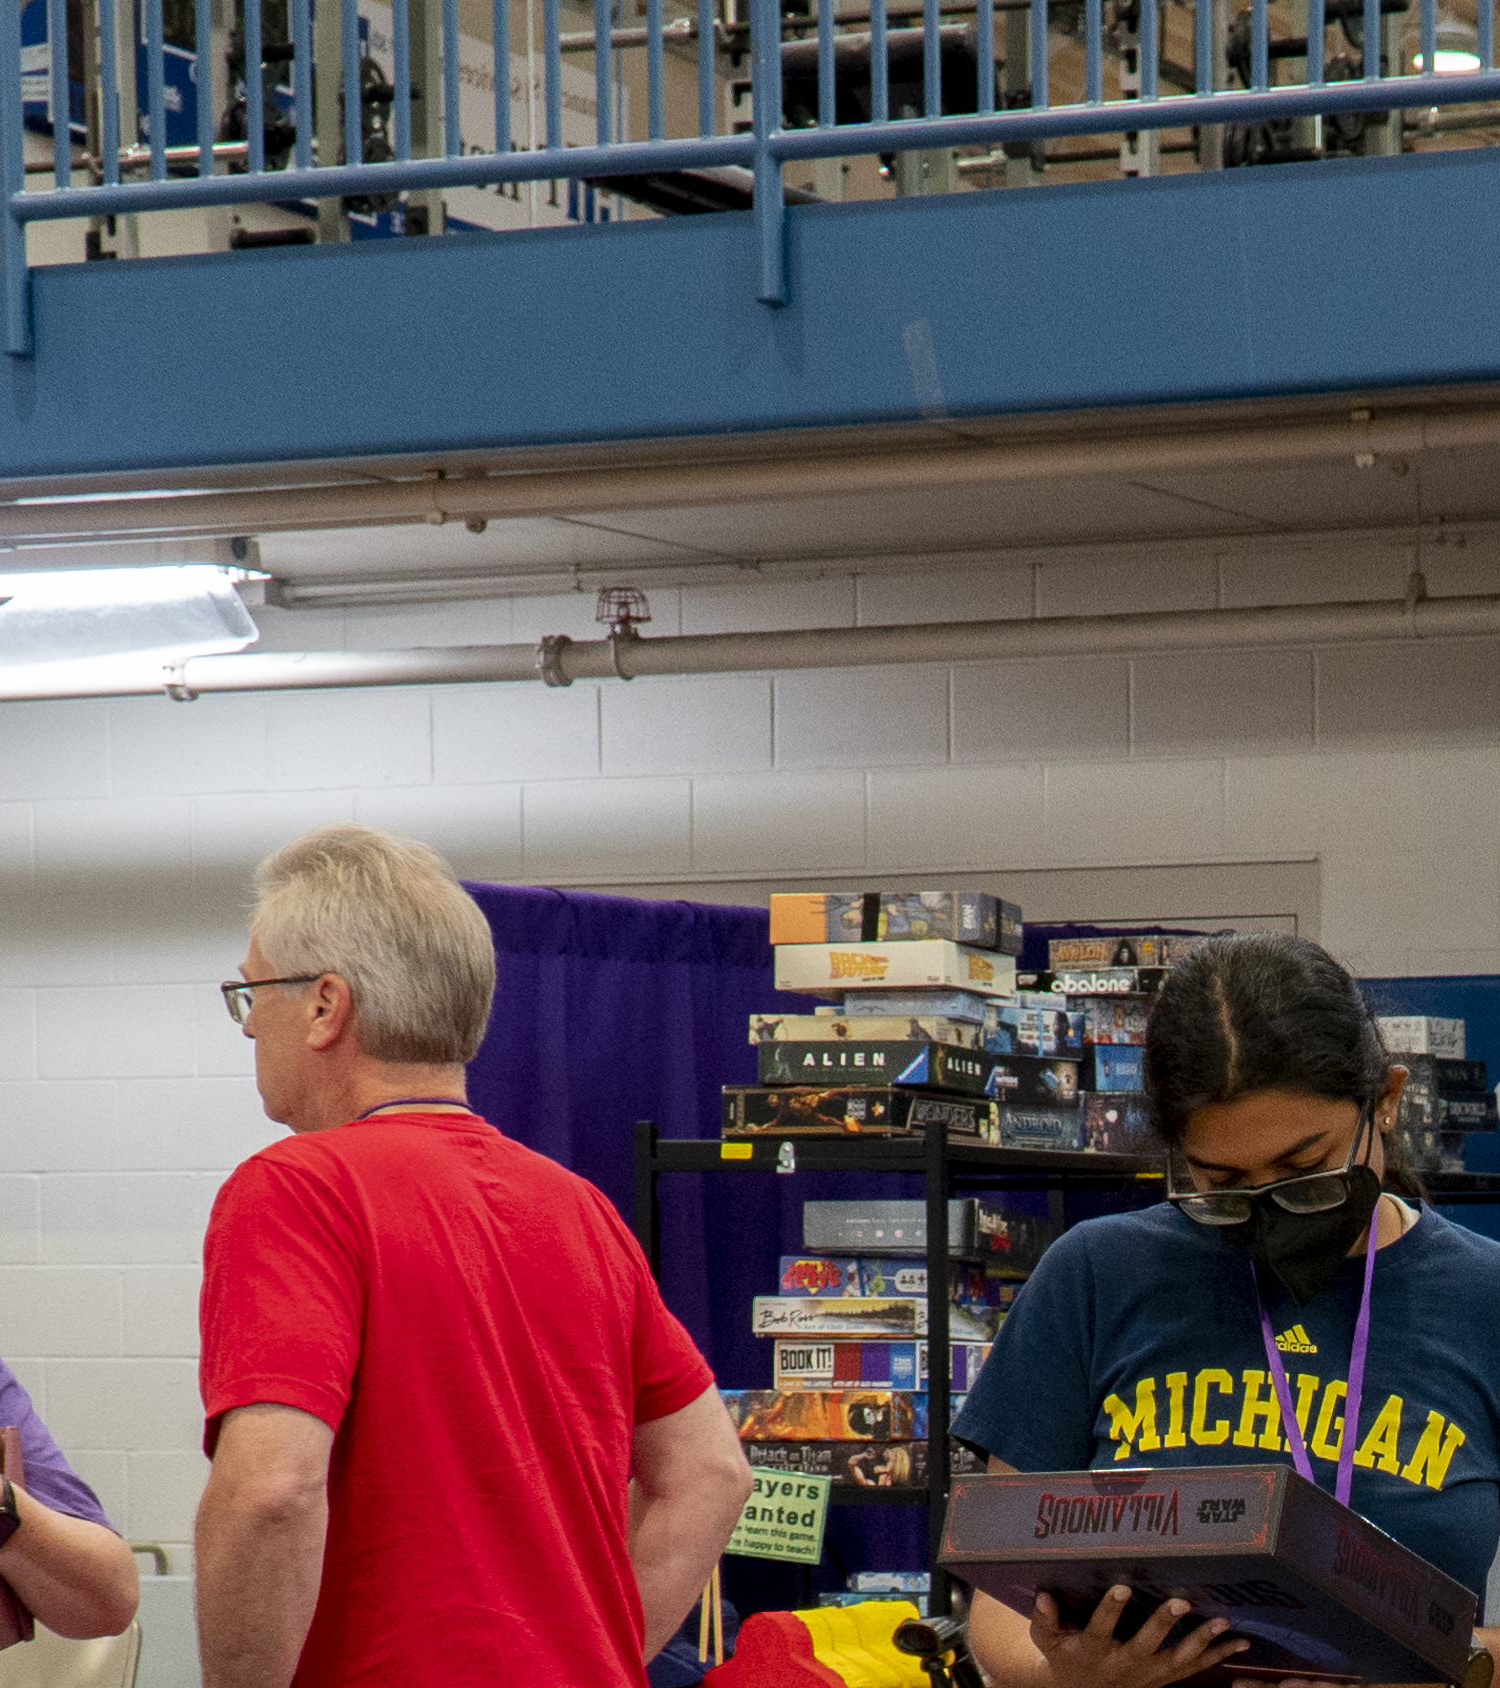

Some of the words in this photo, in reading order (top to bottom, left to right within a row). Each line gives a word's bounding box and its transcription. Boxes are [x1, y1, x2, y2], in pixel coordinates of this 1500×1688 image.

[1051, 974, 1130, 993] abalone
[803, 1053, 886, 1066] ALIEN
[947, 1058, 981, 1076] ALIEN
[781, 1350, 813, 1370] BOOK
[815, 1348, 833, 1369] IT!
[1103, 1368, 1466, 1490] MICHIGAN
[1034, 1488, 1182, 1539] VILLAINOUS
